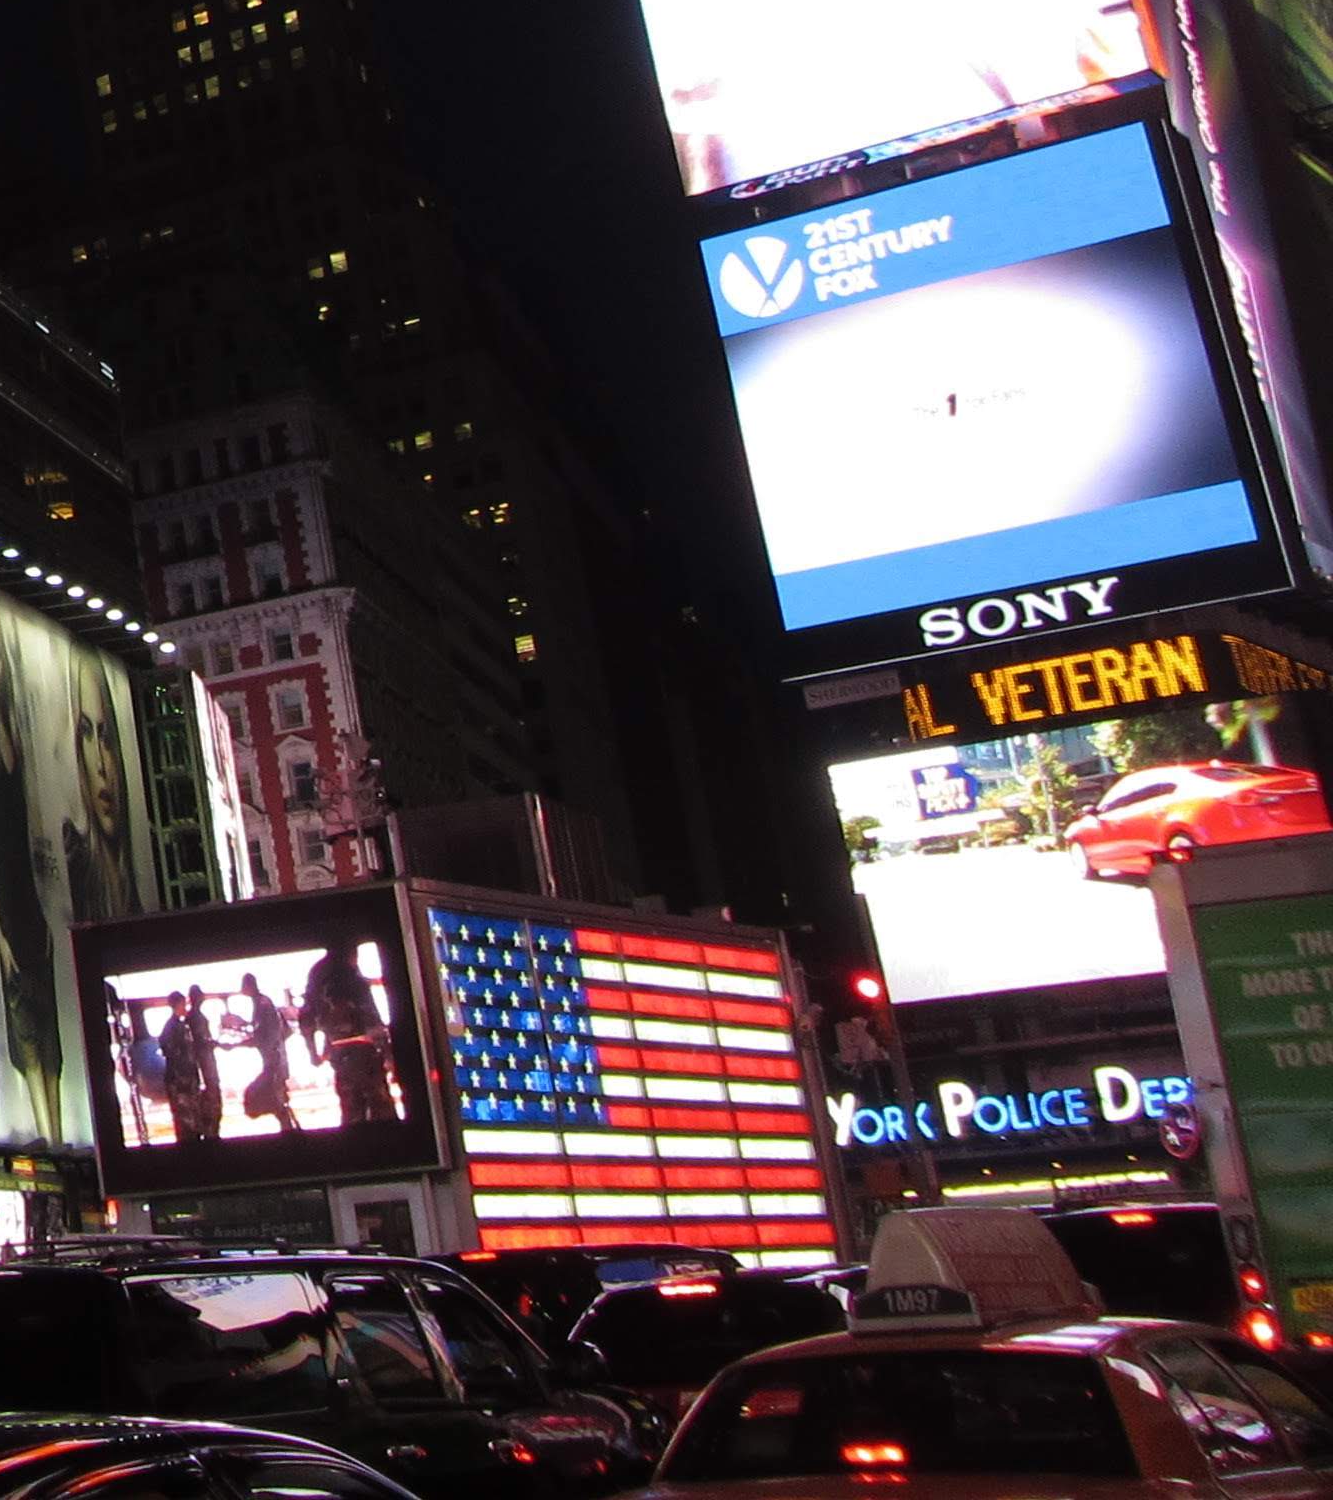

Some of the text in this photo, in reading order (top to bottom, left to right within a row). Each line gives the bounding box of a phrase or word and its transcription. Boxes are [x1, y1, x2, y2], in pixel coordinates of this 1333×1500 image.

[802, 207, 873, 245] 21ST
[808, 214, 954, 278] CENTURY
[814, 271, 879, 302] FOX
[919, 576, 1120, 648] SONY
[970, 634, 1209, 726] VETERAN
[937, 1079, 1091, 1138] POLICE
[1092, 1064, 1196, 1123] DEP
[883, 1286, 941, 1315] 1M97
